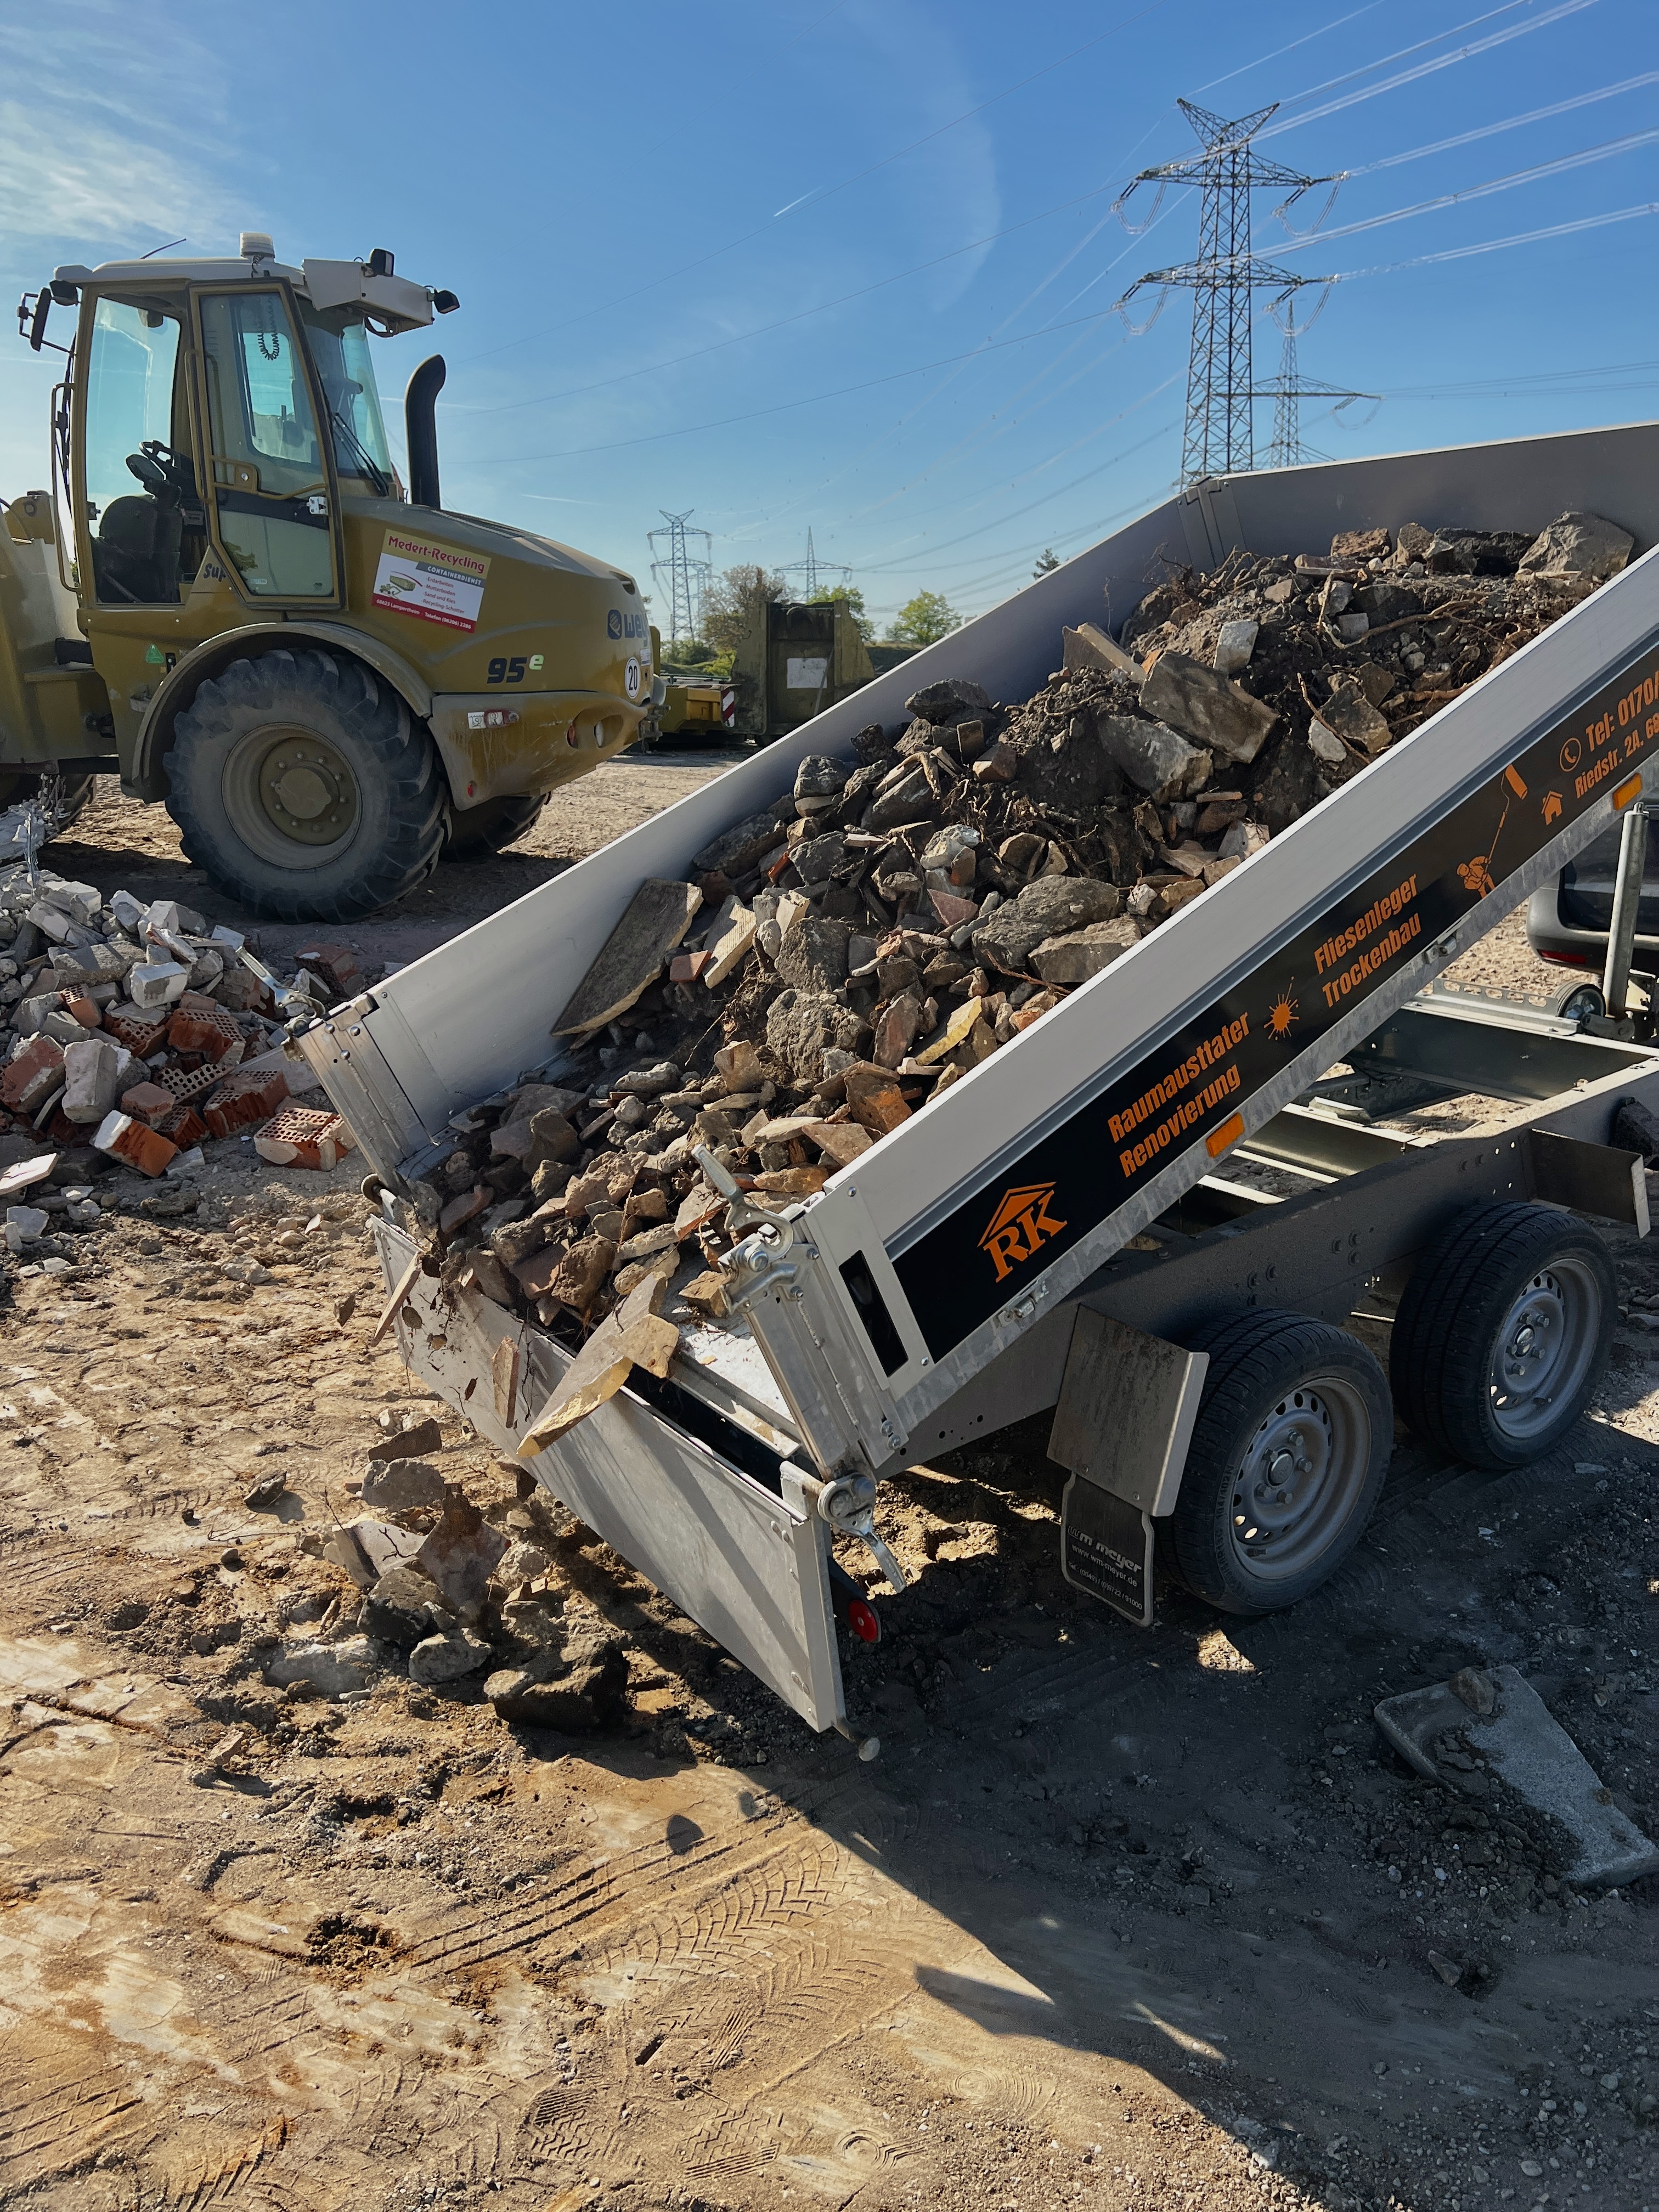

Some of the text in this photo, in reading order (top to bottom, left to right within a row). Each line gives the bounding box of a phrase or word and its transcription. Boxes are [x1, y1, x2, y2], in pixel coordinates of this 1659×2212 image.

[388, 535, 485, 574] Medert-Recycling
[426, 584, 455, 597] Mutterboden
[427, 566, 482, 585] CONTAINERDIENST
[427, 577, 454, 588] Erdarbeiten
[390, 603, 420, 615] Lampertheim
[425, 612, 442, 622] Telefon
[422, 599, 465, 614] Recycling-Schotter
[628, 665, 638, 691] 20
[1586, 712, 1615, 752] Tel:
[1575, 748, 1623, 799] Riedstr.
[1624, 730, 1644, 758] 2A.
[1313, 873, 1417, 975] Fliesenleger
[1322, 913, 1421, 1008] Trockenbau
[1107, 1012, 1250, 1143] Raumausttater
[1119, 1064, 1241, 1178] Renovierung
[983, 1189, 1068, 1283] RK
[1072, 1543, 1137, 1587] www.wm-meyer.de
[1096, 1542, 1142, 1573] meyer
[1125, 1595, 1142, 1610] 91000
